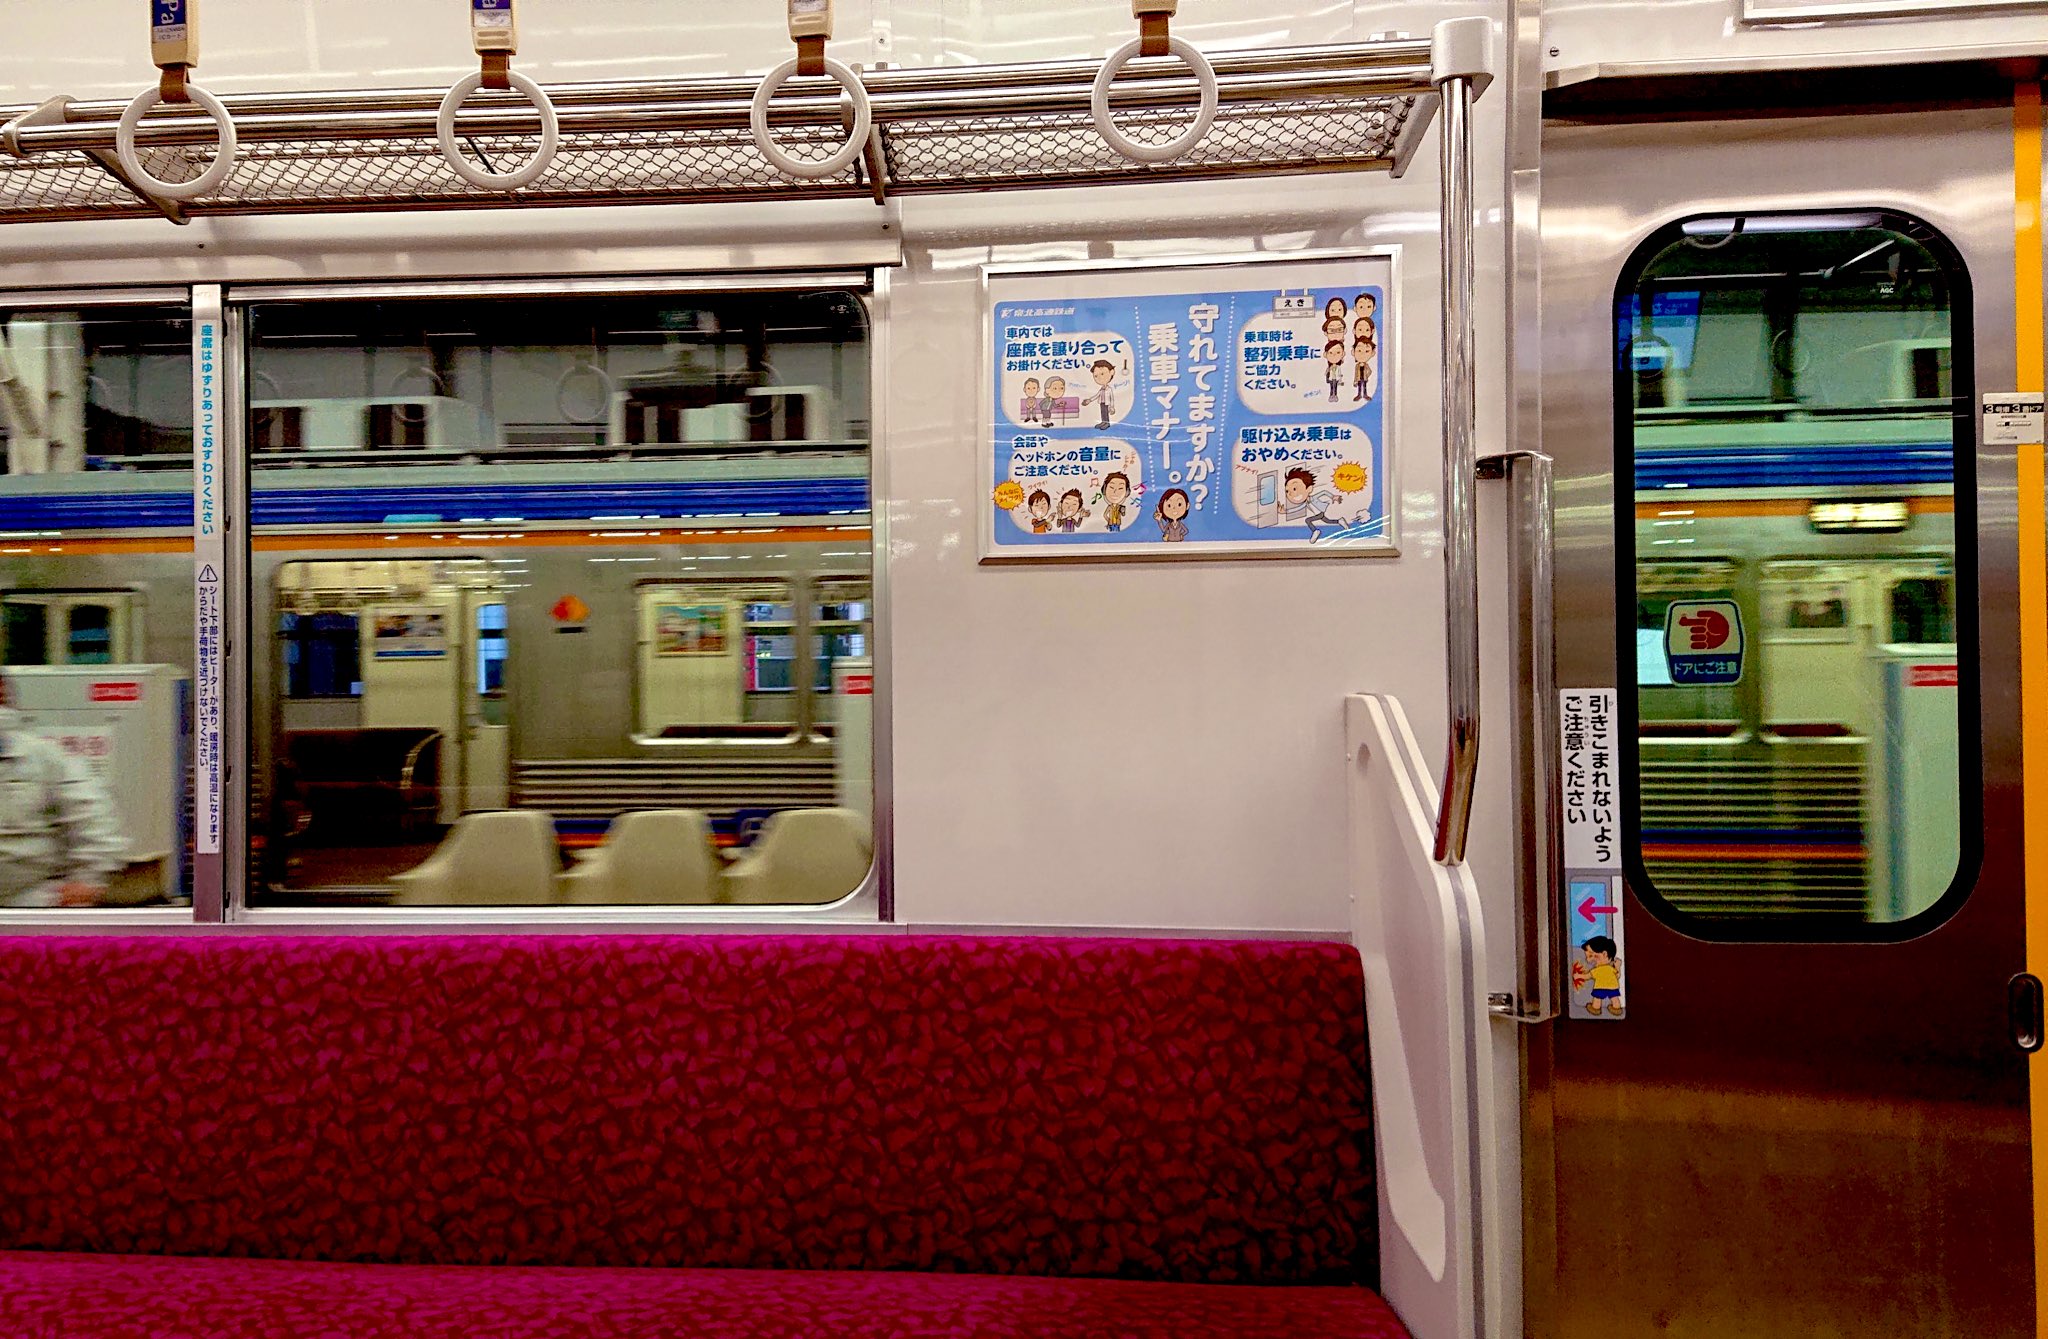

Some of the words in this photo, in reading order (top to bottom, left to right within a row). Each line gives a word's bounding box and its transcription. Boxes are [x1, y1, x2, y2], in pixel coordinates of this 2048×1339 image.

[1284, 299, 1304, 307] えき
[1006, 326, 1052, 339] 車内では
[1244, 330, 1293, 343] 乗車時は
[1006, 339, 1124, 358] 座席を譲り合って
[1244, 345, 1321, 362] 整列乗車に
[1006, 358, 1091, 371] お掛けください。
[1244, 363, 1281, 376] ご協力
[1244, 379, 1297, 390] ください。
[1148, 321, 1182, 484] 乗車マナー。
[1186, 302, 1220, 511] 守れてますか?
[201, 324, 214, 535] 座席はゆずりあっておすわりください
[1241, 426, 1352, 443] 駆け込み乗車は
[1014, 437, 1049, 448] 会話や
[1014, 446, 1121, 463] ヘッドホンの音量に
[1241, 446, 1343, 462] おやめください。
[1014, 464, 1099, 477] ご注意ください。
[1674, 661, 1738, 676] ドアにご注意
[1564, 695, 1587, 824] ご注意ください
[1589, 694, 1612, 863] 引きこまれないよう
